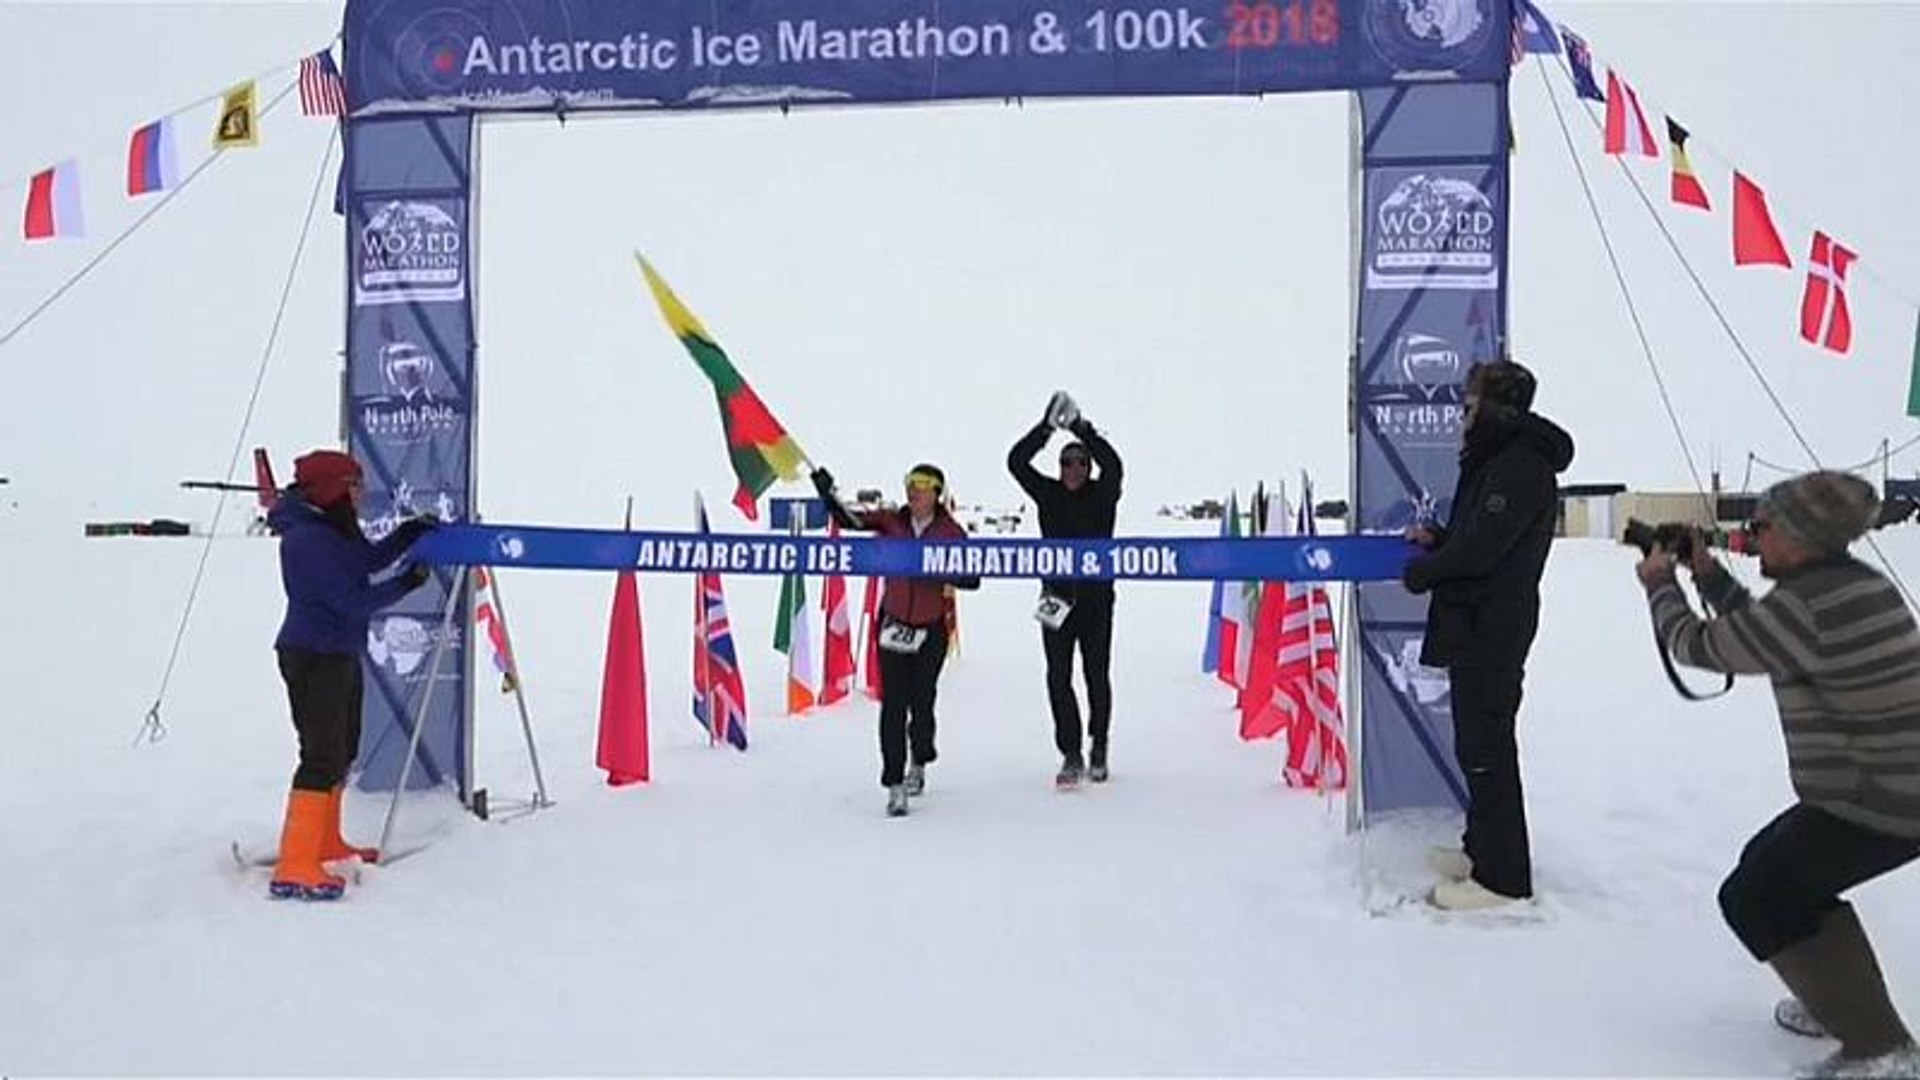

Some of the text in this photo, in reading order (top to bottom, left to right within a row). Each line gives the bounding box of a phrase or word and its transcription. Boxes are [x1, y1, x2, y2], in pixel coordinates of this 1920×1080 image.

[462, 0, 1340, 76] Antarctic Ice Marathon & 100k 2018
[1378, 236, 1493, 251] MARATHON
[1376, 405, 1438, 424] North
[637, 540, 1178, 575] ANTARCTIC ICE MARATHON & 100k
[890, 627, 916, 645] 28
